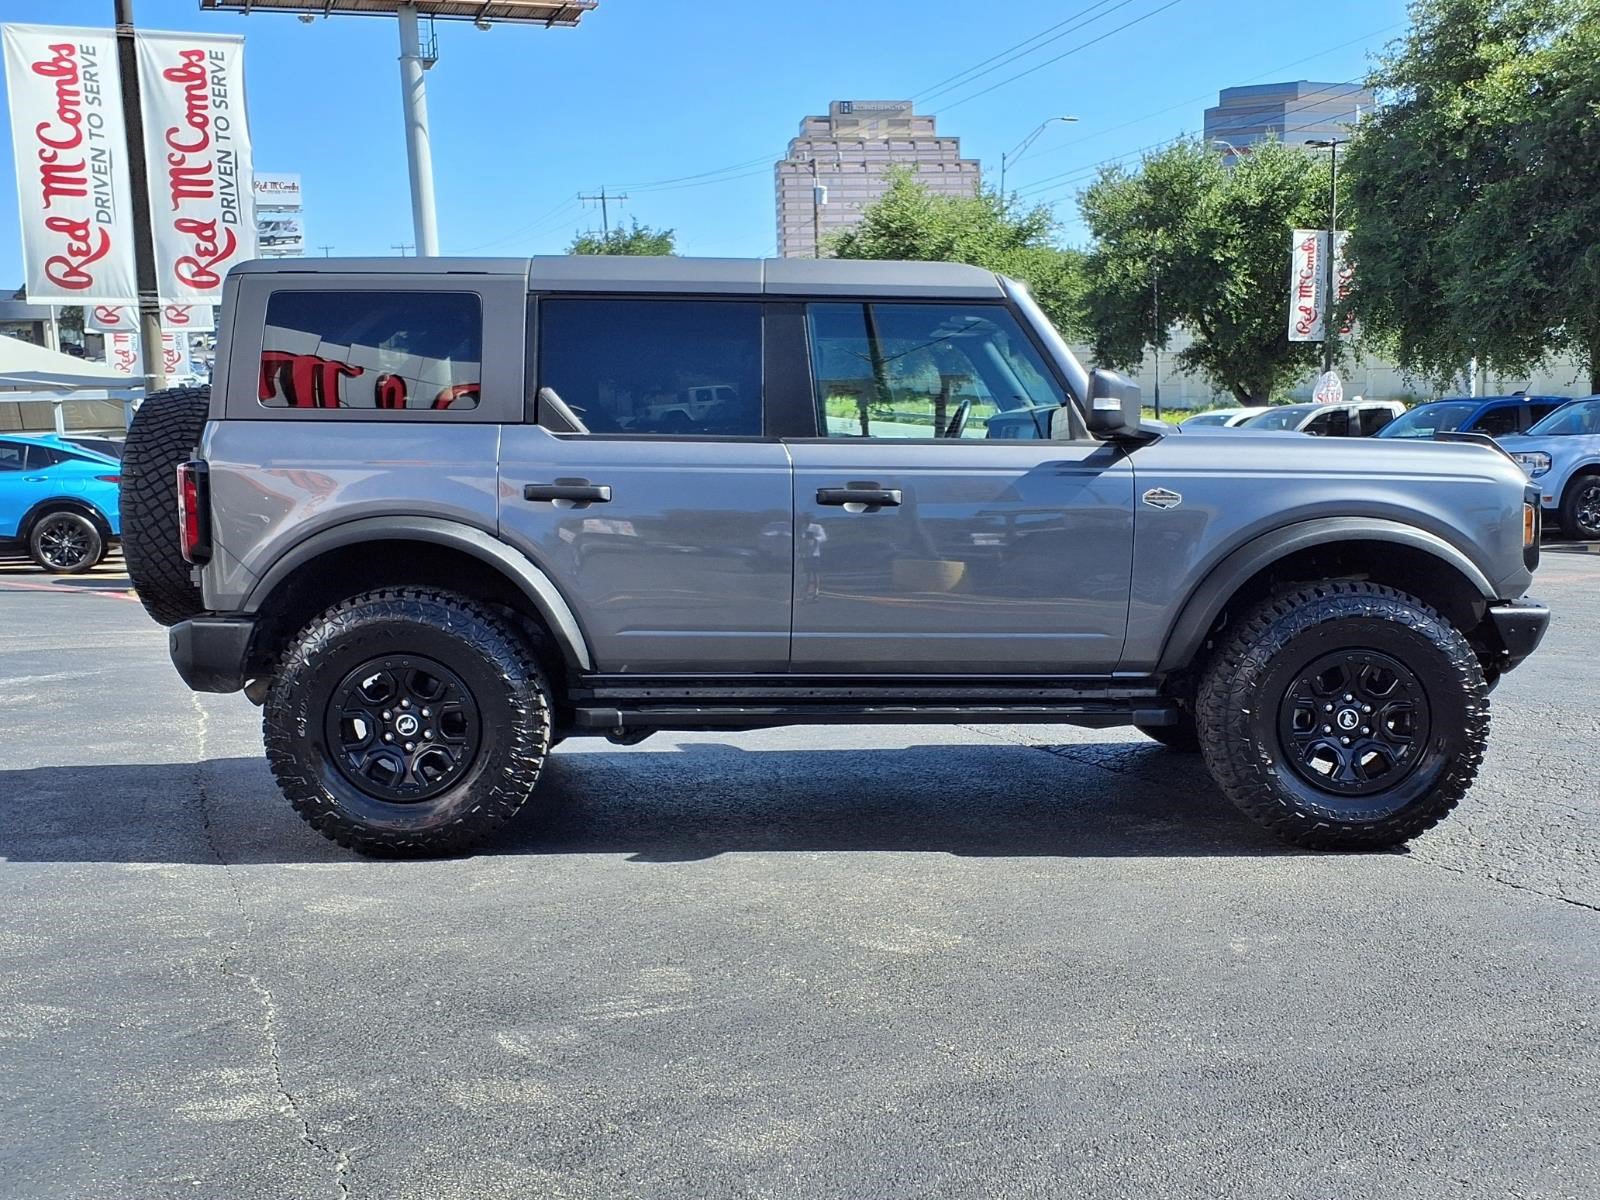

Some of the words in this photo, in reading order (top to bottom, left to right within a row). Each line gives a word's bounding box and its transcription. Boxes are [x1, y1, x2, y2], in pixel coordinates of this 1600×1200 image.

[79, 44, 102, 107] SERVE
[209, 50, 229, 110] SERVE
[31, 43, 88, 209] McCombs
[87, 112, 105, 140] TO
[163, 49, 214, 212] McCombs
[214, 115, 231, 142] TO
[90, 147, 112, 224] DRIVEN
[216, 149, 237, 225] DRIVEN
[45, 216, 111, 290] Red
[174, 218, 237, 290] Red
[1298, 236, 1316, 301] McCombs
[1296, 306, 1318, 335] Red
[114, 349, 137, 374] Red
